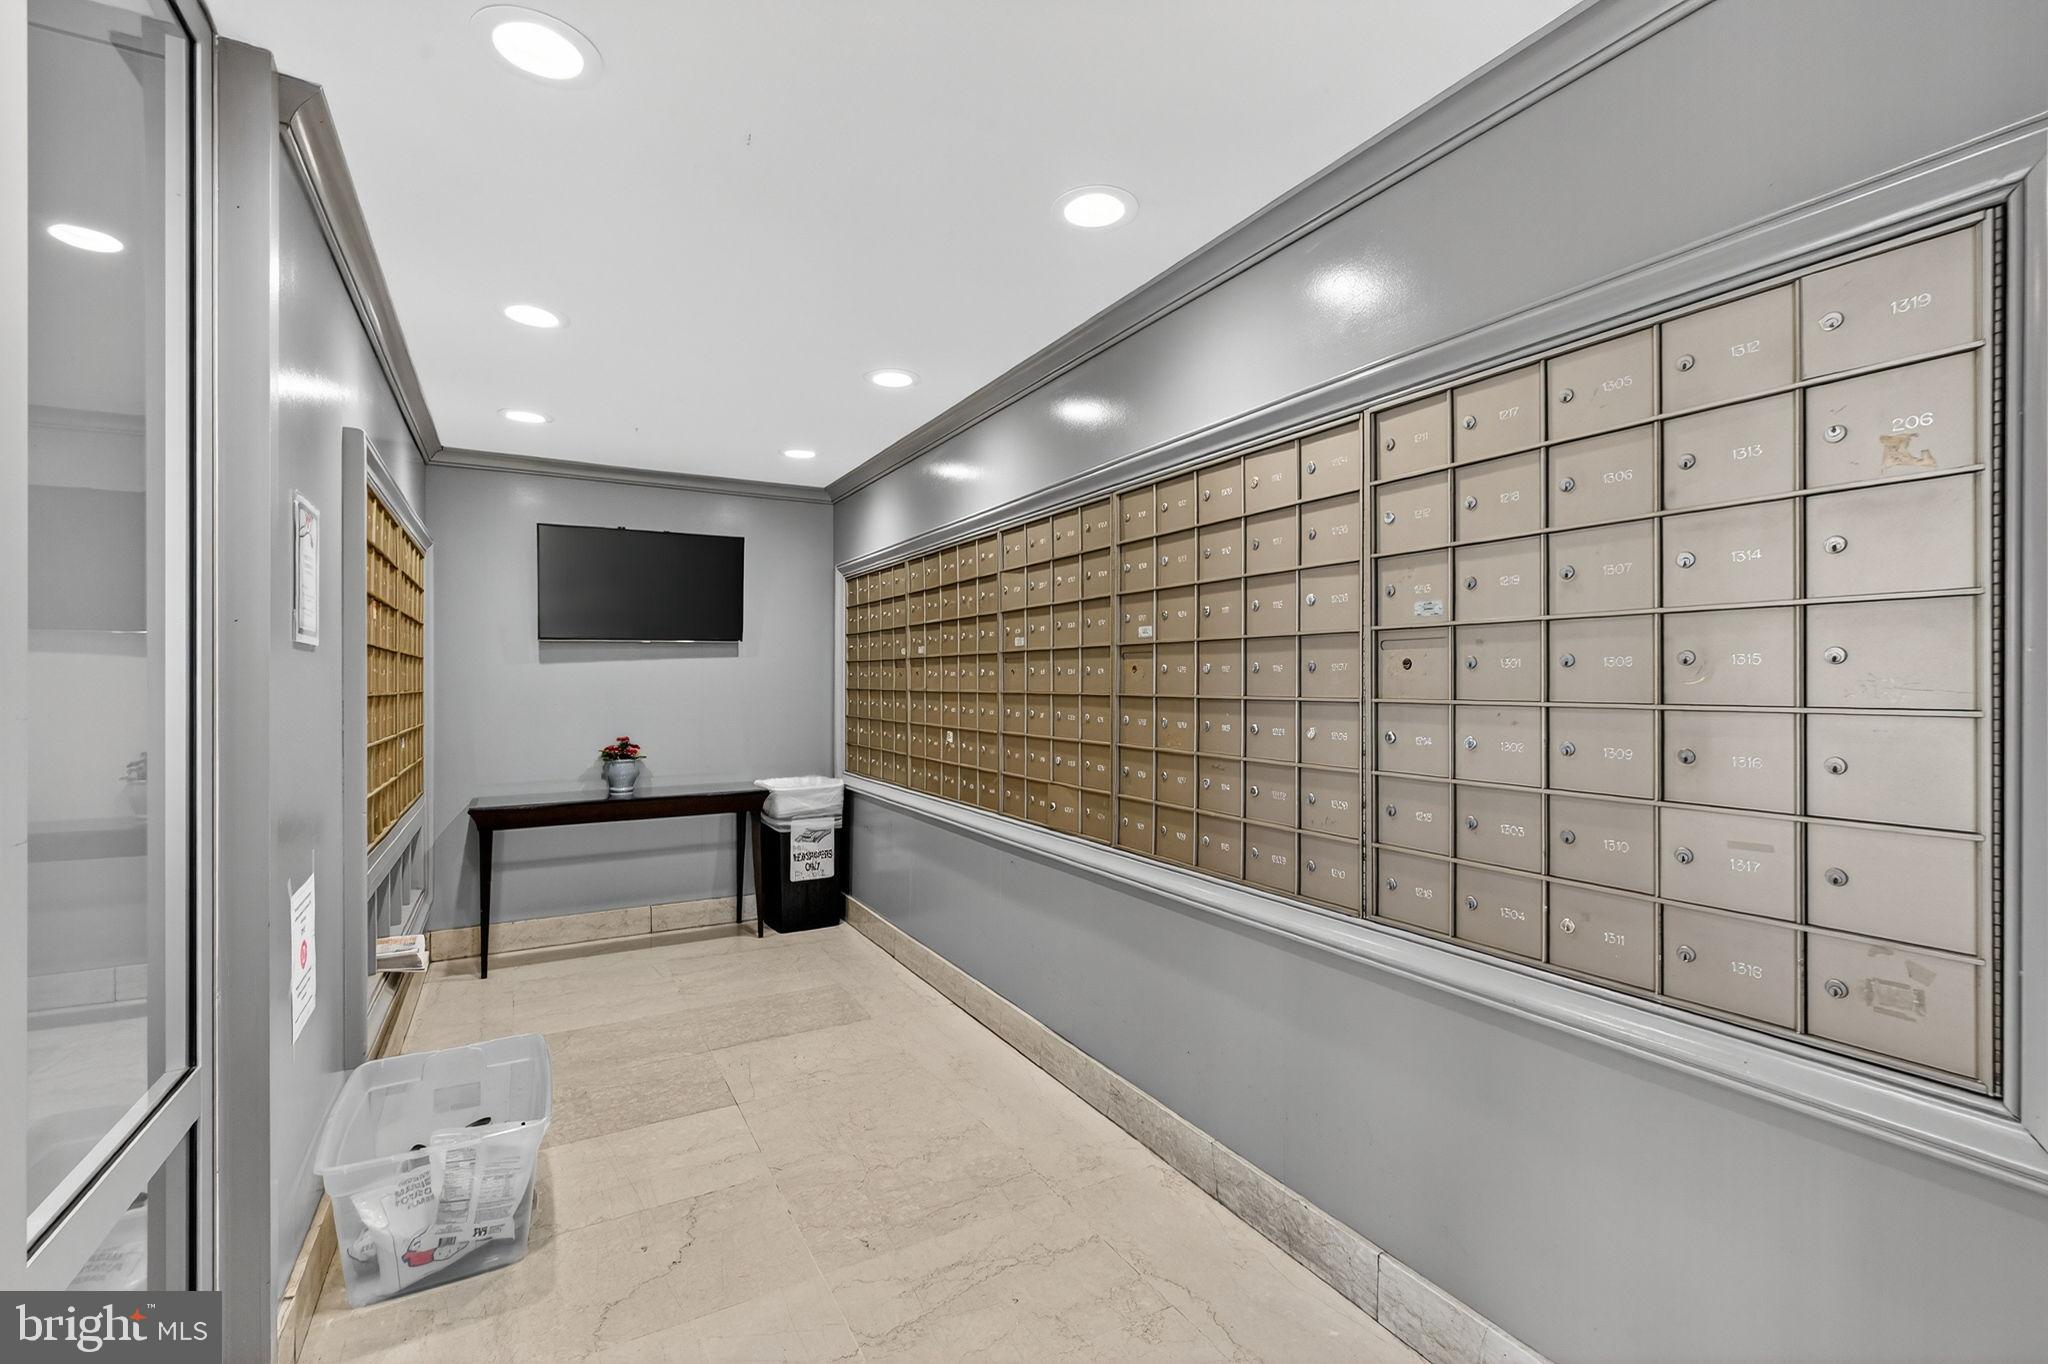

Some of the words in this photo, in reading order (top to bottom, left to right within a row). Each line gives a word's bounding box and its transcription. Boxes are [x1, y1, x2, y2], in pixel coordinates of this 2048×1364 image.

[1890, 292, 1932, 315] 1319
[1730, 339, 1761, 357] 1312
[1601, 375, 1633, 393] 1305
[1891, 411, 1934, 432] 206
[1732, 444, 1763, 460] 1313
[1603, 469, 1633, 484] 1306
[1731, 548, 1762, 563] 1314
[1602, 562, 1633, 576] 1307
[1731, 652, 1762, 666] 1315
[1603, 747, 1634, 761] 1309
[1732, 755, 1763, 770] 1316
[1500, 823, 1525, 837] 1303
[1603, 839, 1630, 854] 1310
[1730, 858, 1761, 873] 1317
[1500, 907, 1526, 921] 1304
[1603, 931, 1625, 946] 1311
[1731, 961, 1763, 979] 1318
